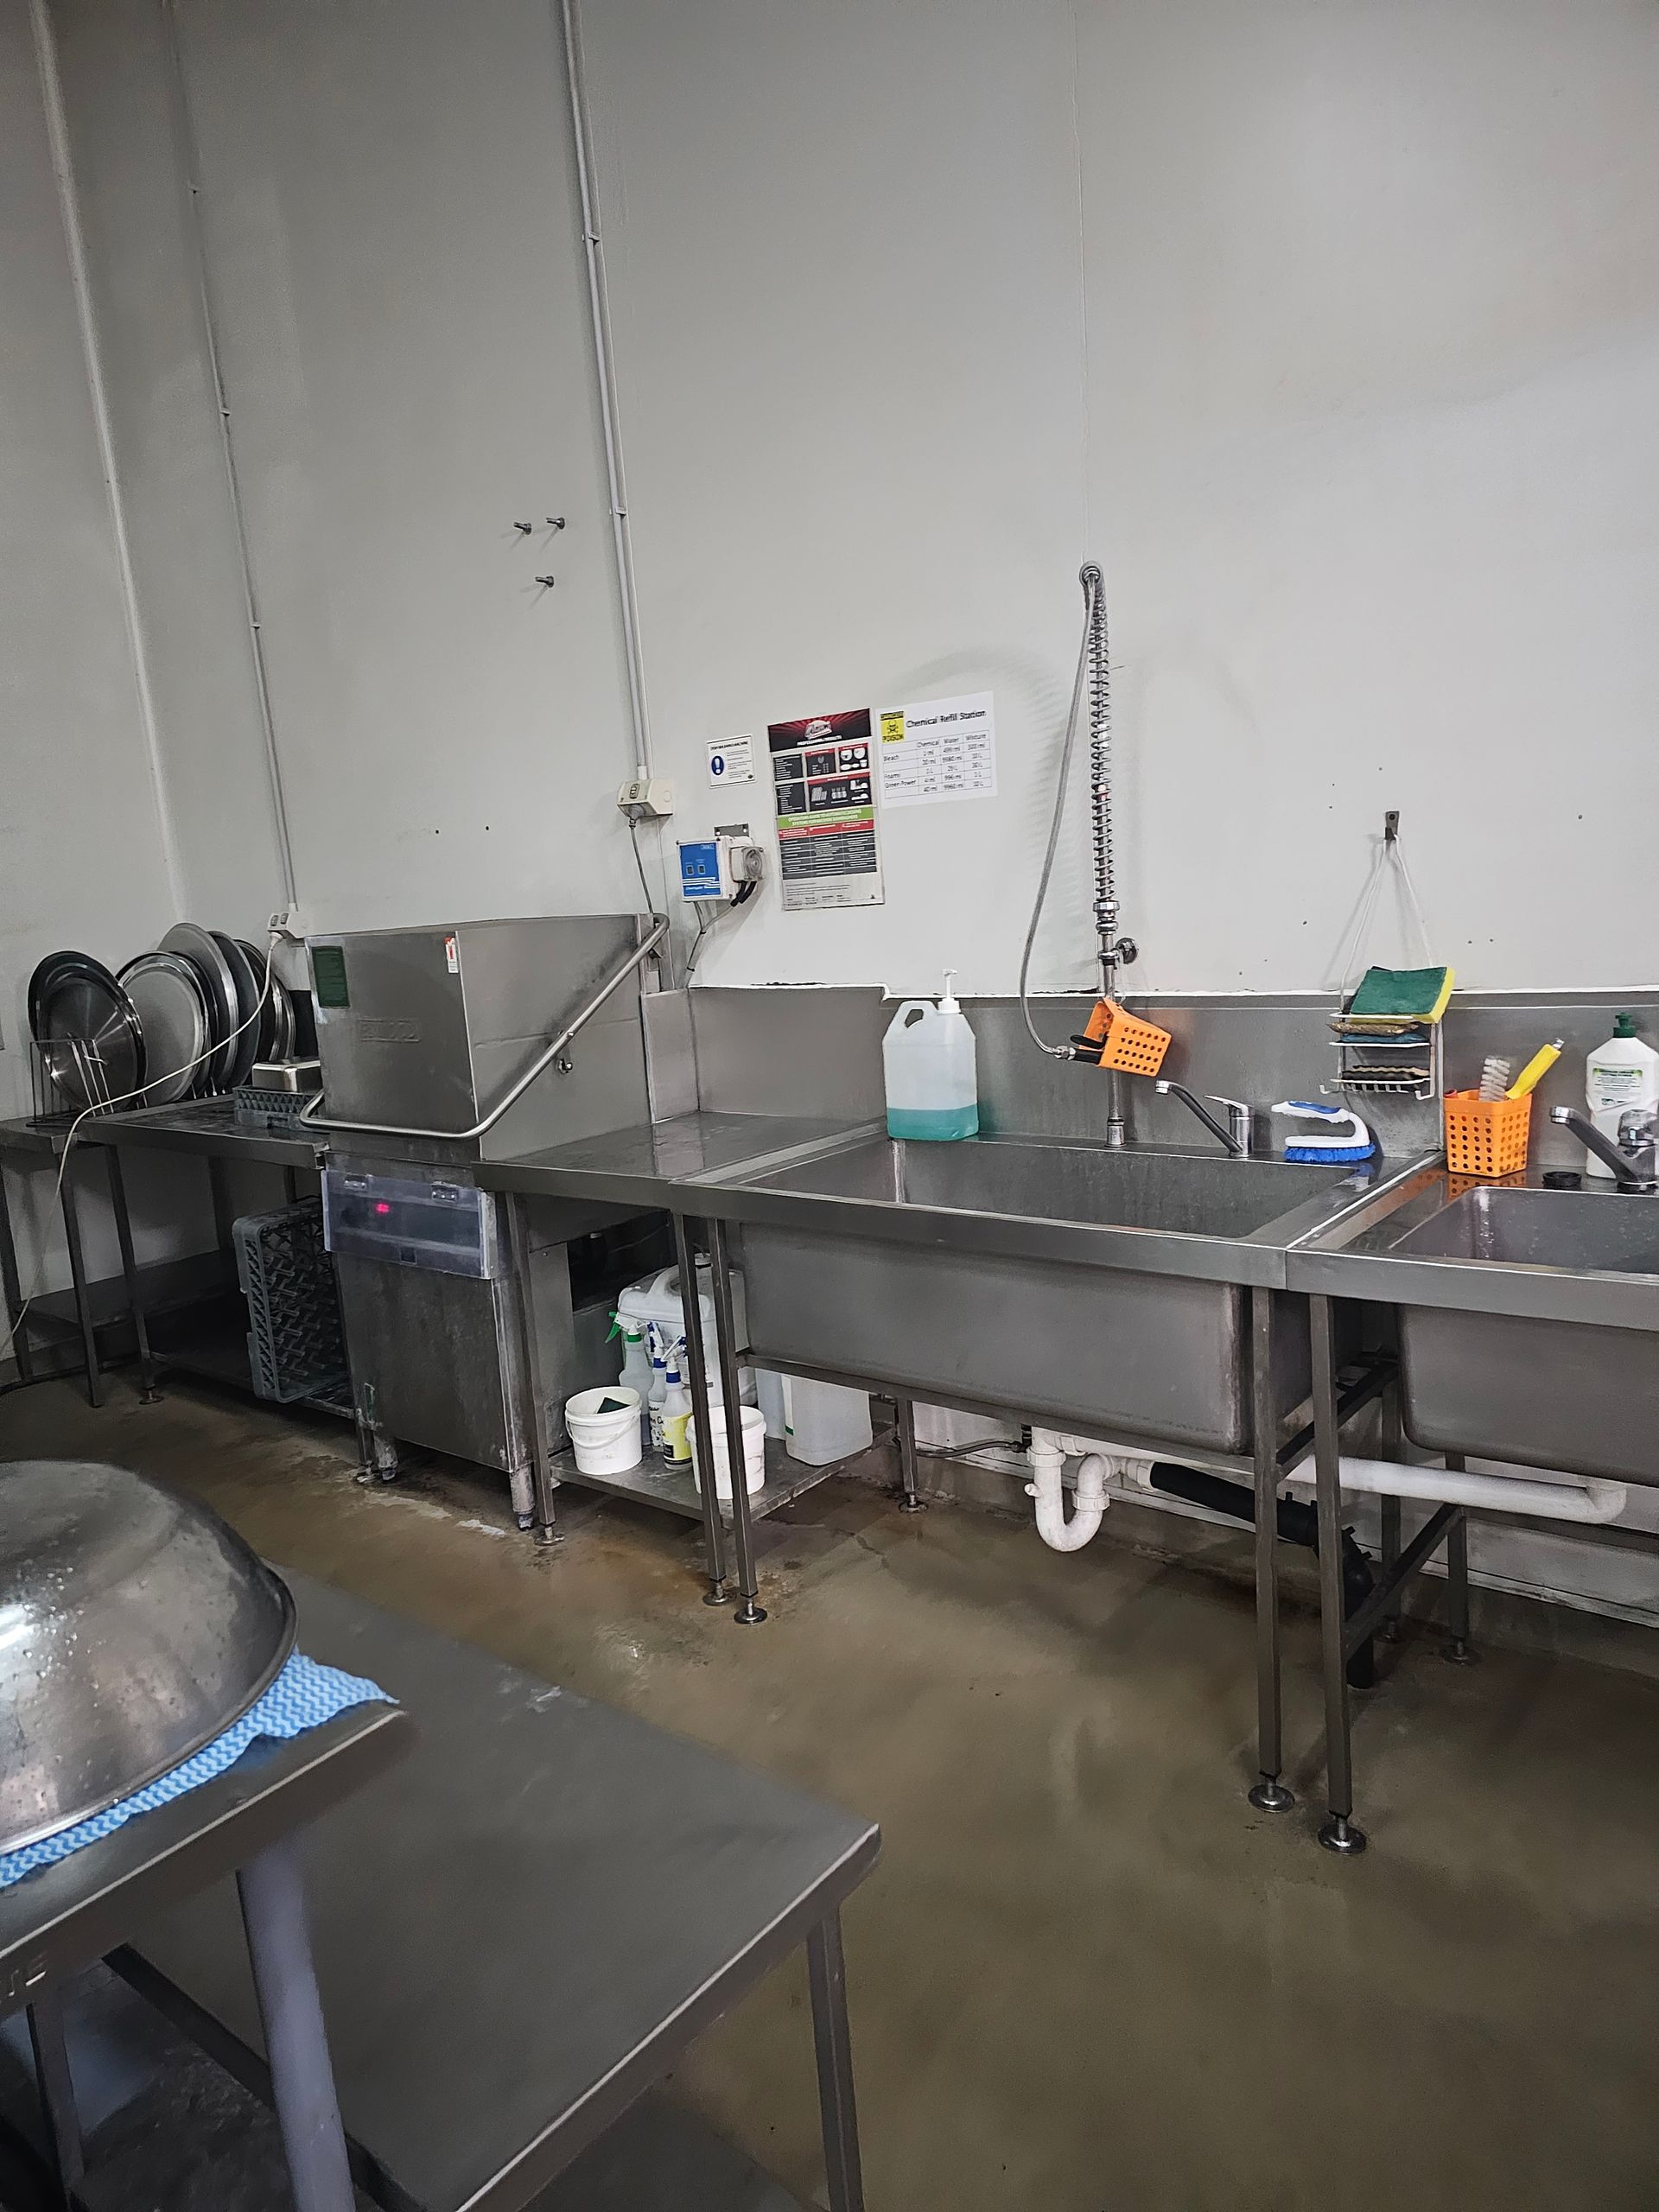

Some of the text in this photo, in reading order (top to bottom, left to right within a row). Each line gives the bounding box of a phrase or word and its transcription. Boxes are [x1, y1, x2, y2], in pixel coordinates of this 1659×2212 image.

[906, 709, 986, 728] Chemical Refill Station
[881, 734, 904, 743] POISON
[917, 739, 939, 748] Chemical
